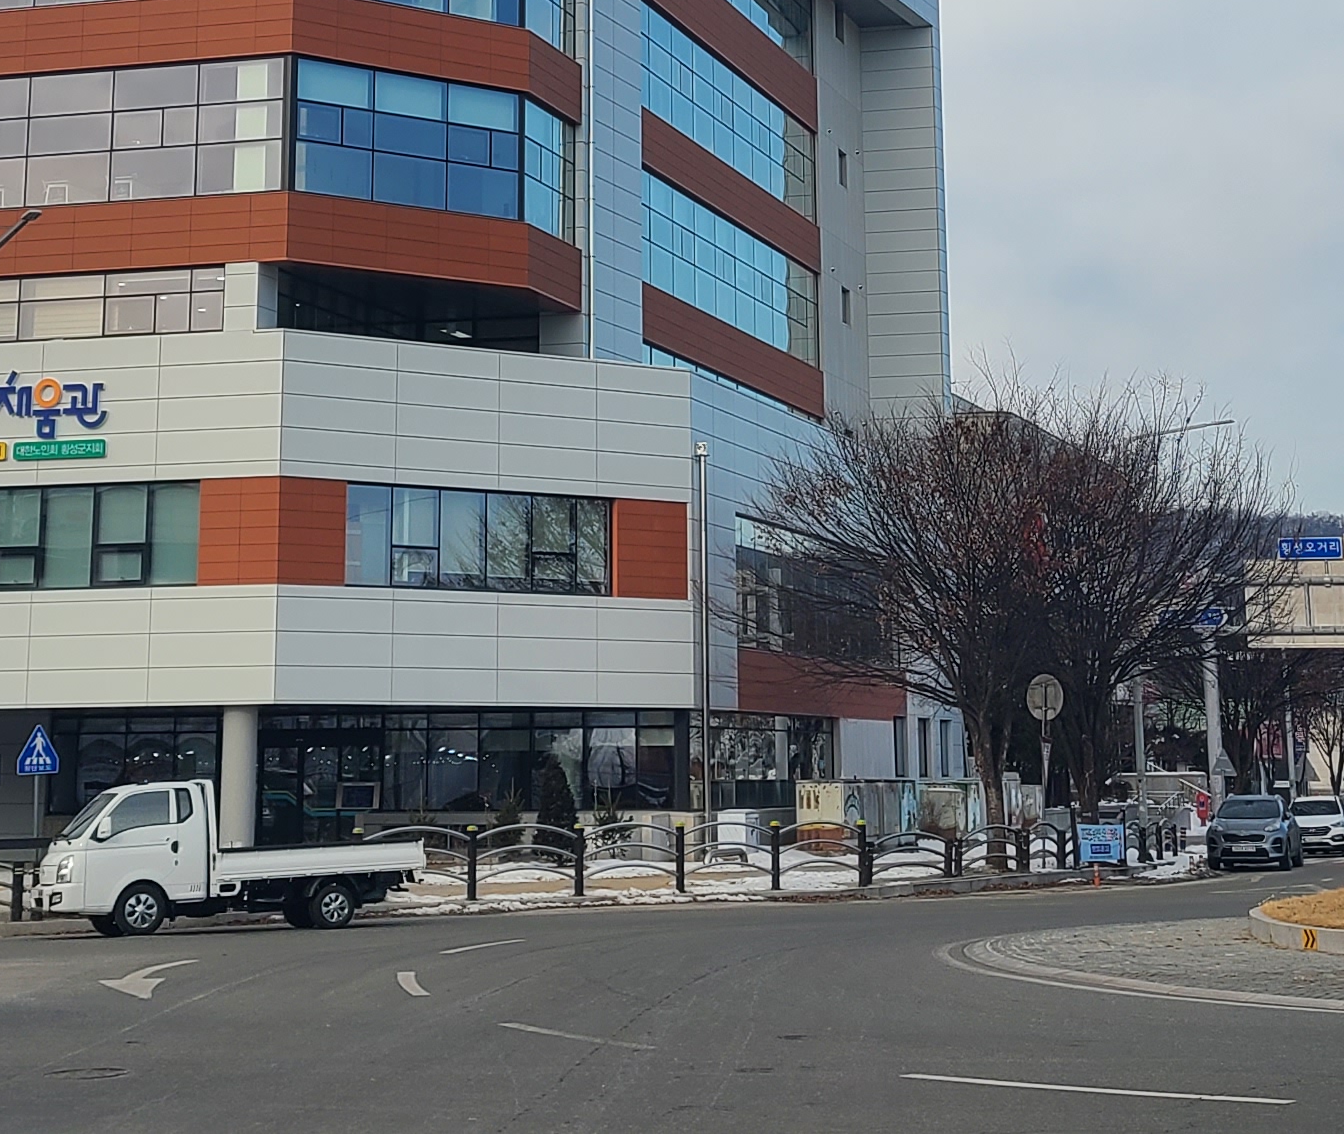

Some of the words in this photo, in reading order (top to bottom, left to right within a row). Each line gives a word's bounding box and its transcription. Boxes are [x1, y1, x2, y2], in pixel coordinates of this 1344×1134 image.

[15, 444, 58, 458] 대한노인회
[61, 441, 104, 455] 횡성군지회
[1280, 540, 1340, 556] 횡성오거리
